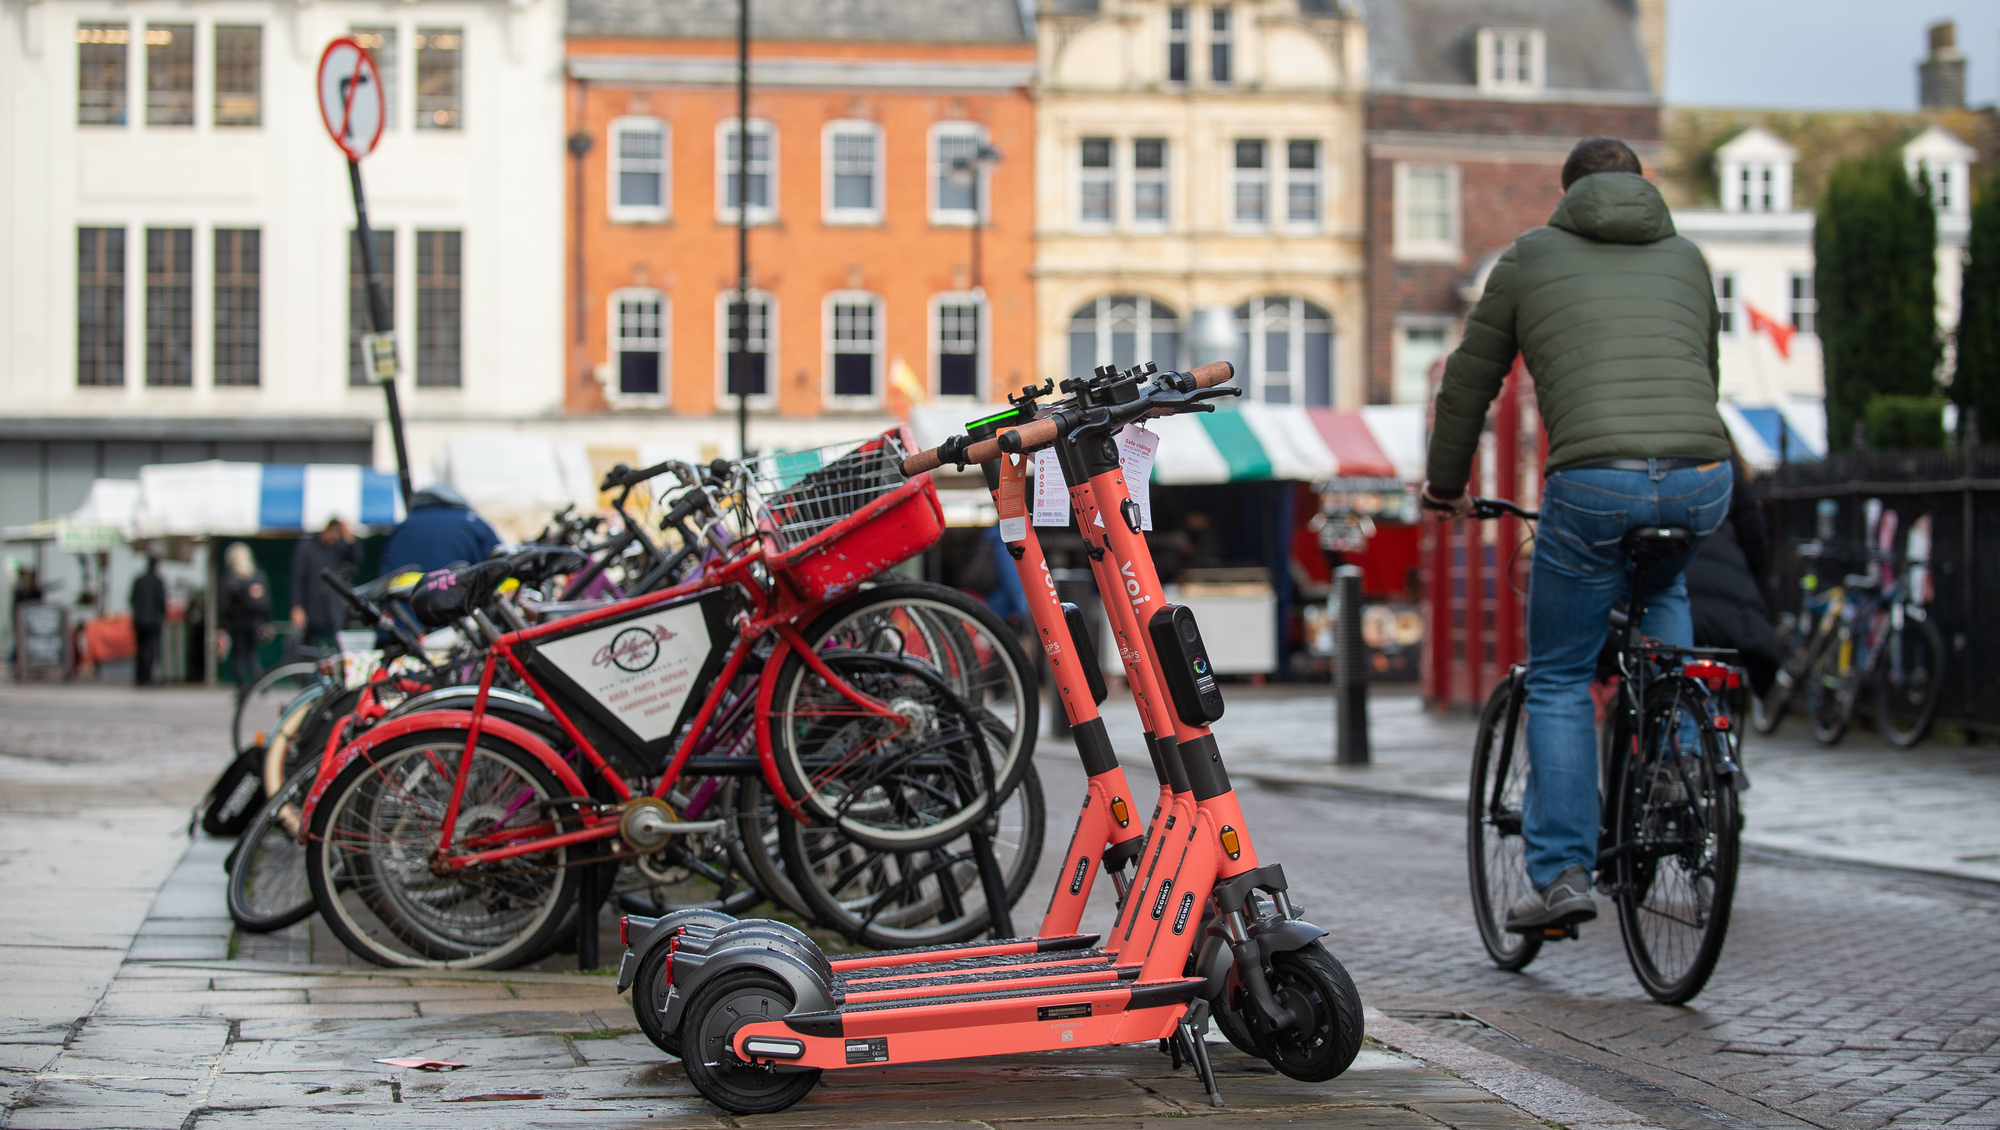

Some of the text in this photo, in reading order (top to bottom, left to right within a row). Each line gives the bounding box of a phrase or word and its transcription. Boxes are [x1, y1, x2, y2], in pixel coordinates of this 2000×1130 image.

[1136, 443, 1151, 452] riding
[1121, 560, 1150, 614] voi.
[1045, 642, 1059, 652] GPS
[609, 689, 628, 701] BIKES
[660, 668, 688, 683] REPAIRS
[619, 684, 686, 713] CAMBRIDGE MARKET
[1074, 860, 1086, 890] SEGWAY
[1156, 884, 1169, 914] SEGWAY
[1177, 897, 1191, 929] SEGWAY
